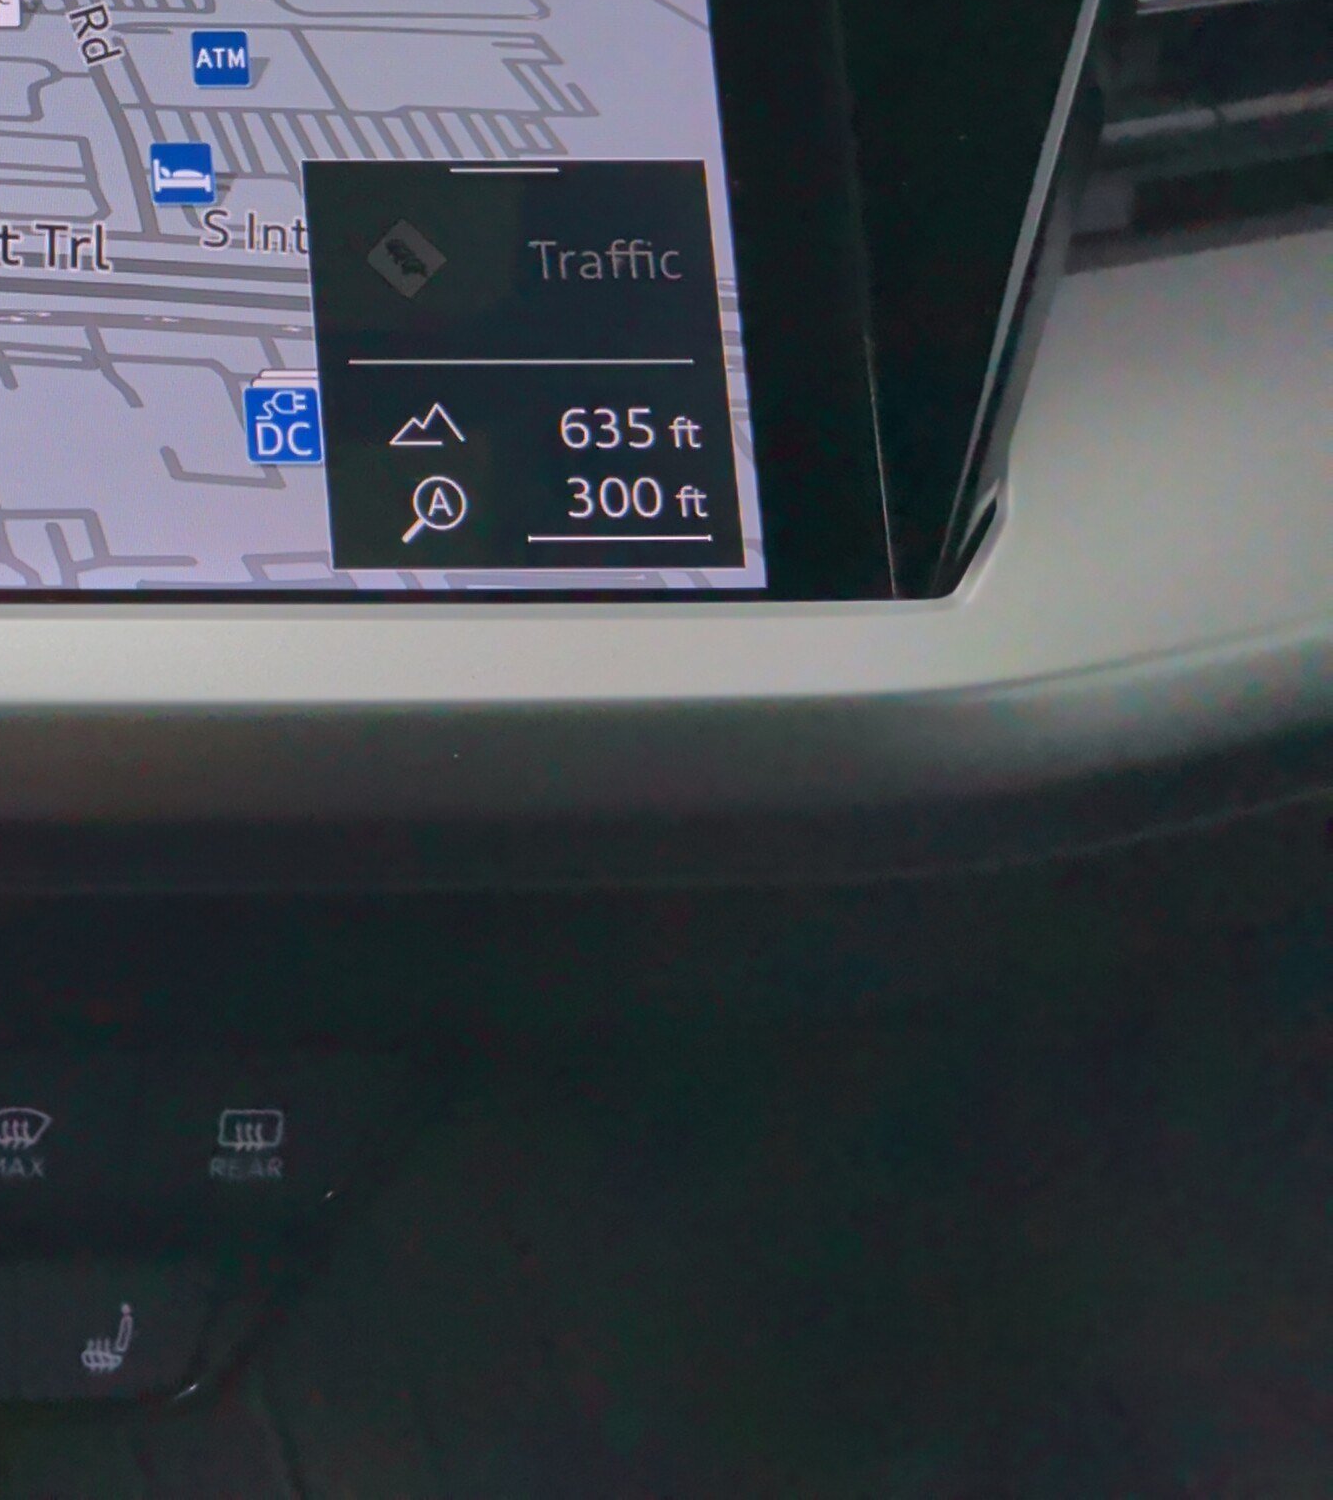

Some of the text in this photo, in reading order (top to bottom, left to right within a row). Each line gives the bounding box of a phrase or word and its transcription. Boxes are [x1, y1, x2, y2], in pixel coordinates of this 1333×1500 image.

[69, 3, 123, 65] Rd
[195, 47, 247, 70] ATM
[36, 222, 113, 270] Trl
[203, 208, 229, 248] S
[527, 239, 684, 282] Traffic
[255, 420, 314, 458] DC
[559, 406, 702, 449] 635 ft
[565, 476, 708, 519] 300 ft
[209, 1155, 284, 1180] REAR
